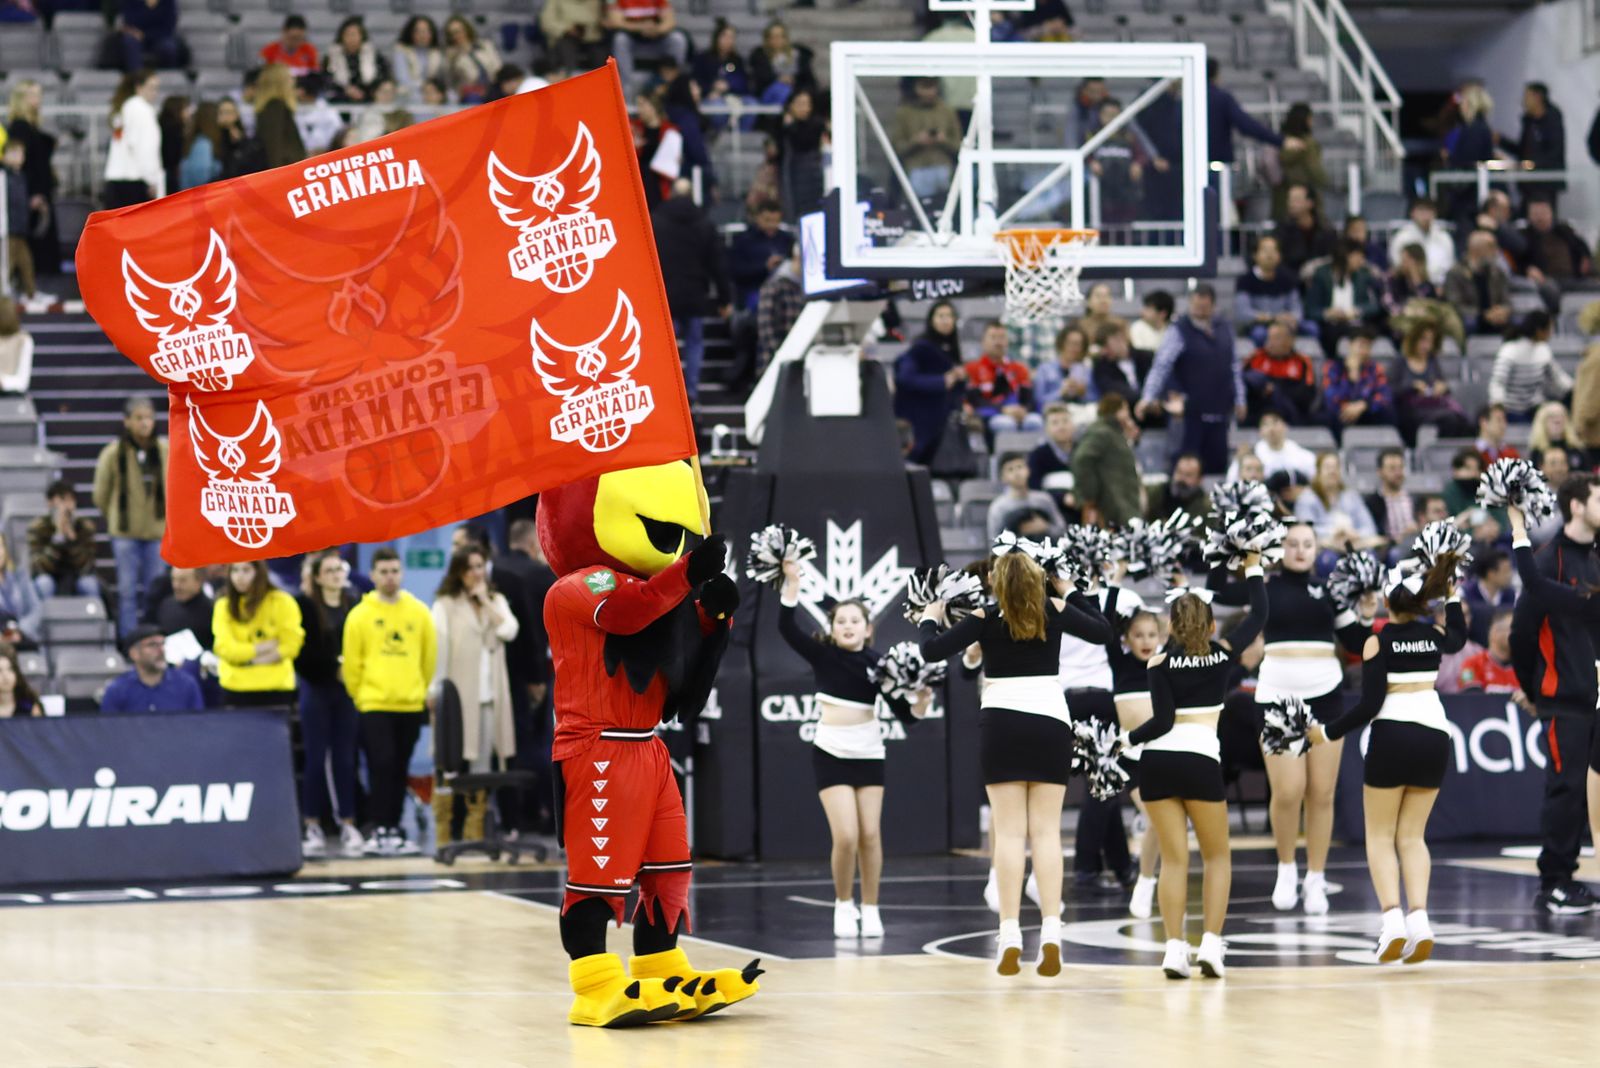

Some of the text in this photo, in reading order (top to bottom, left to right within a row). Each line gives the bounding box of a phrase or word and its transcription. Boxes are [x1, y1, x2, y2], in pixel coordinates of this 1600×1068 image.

[303, 147, 395, 181] COVIRAN
[286, 159, 426, 219] GRANADA
[524, 215, 590, 243] COVIRAN
[512, 223, 611, 272] GRANADA
[164, 328, 227, 351] COVIRAN
[154, 337, 248, 374] GRANADA
[567, 383, 631, 411] COVIRAN
[554, 390, 649, 435] GRANADA
[205, 491, 290, 515] GRANADA
[213, 483, 270, 495] COVIRAN
[1169, 650, 1229, 669] MARTINA
[1391, 639, 1438, 653] DANIELA
